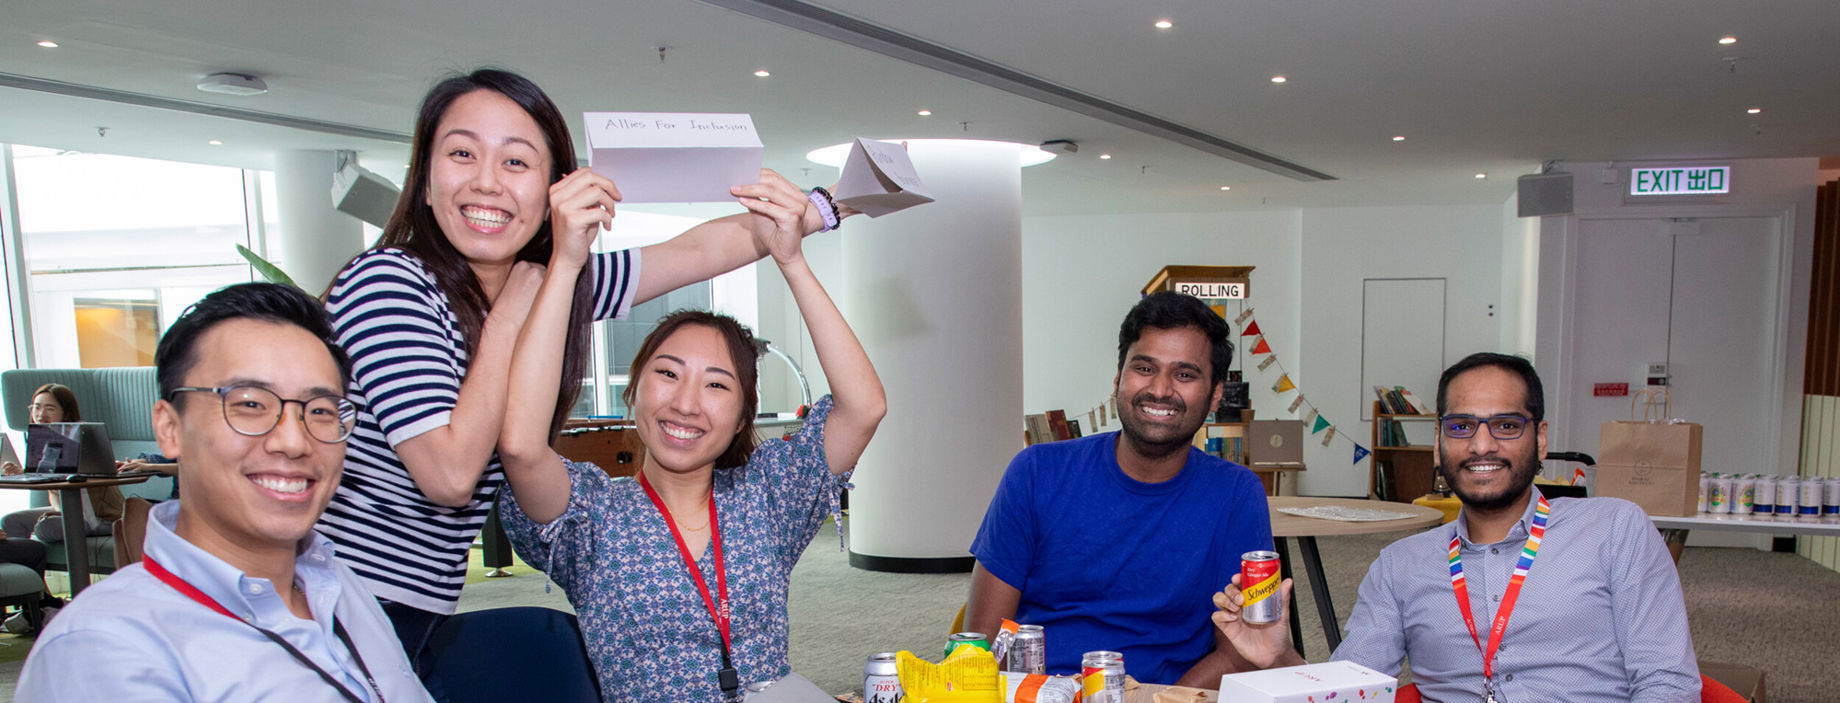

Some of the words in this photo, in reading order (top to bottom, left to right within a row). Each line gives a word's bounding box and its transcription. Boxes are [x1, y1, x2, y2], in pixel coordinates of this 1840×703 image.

[604, 119, 646, 130] Allies
[655, 120, 676, 129] For
[689, 119, 747, 131] Inclusion
[1637, 169, 1684, 192] EXIT
[1687, 168, 1724, 190] 出口
[1181, 284, 1239, 297] ROLLING
[1248, 577, 1279, 600] Schweppe
